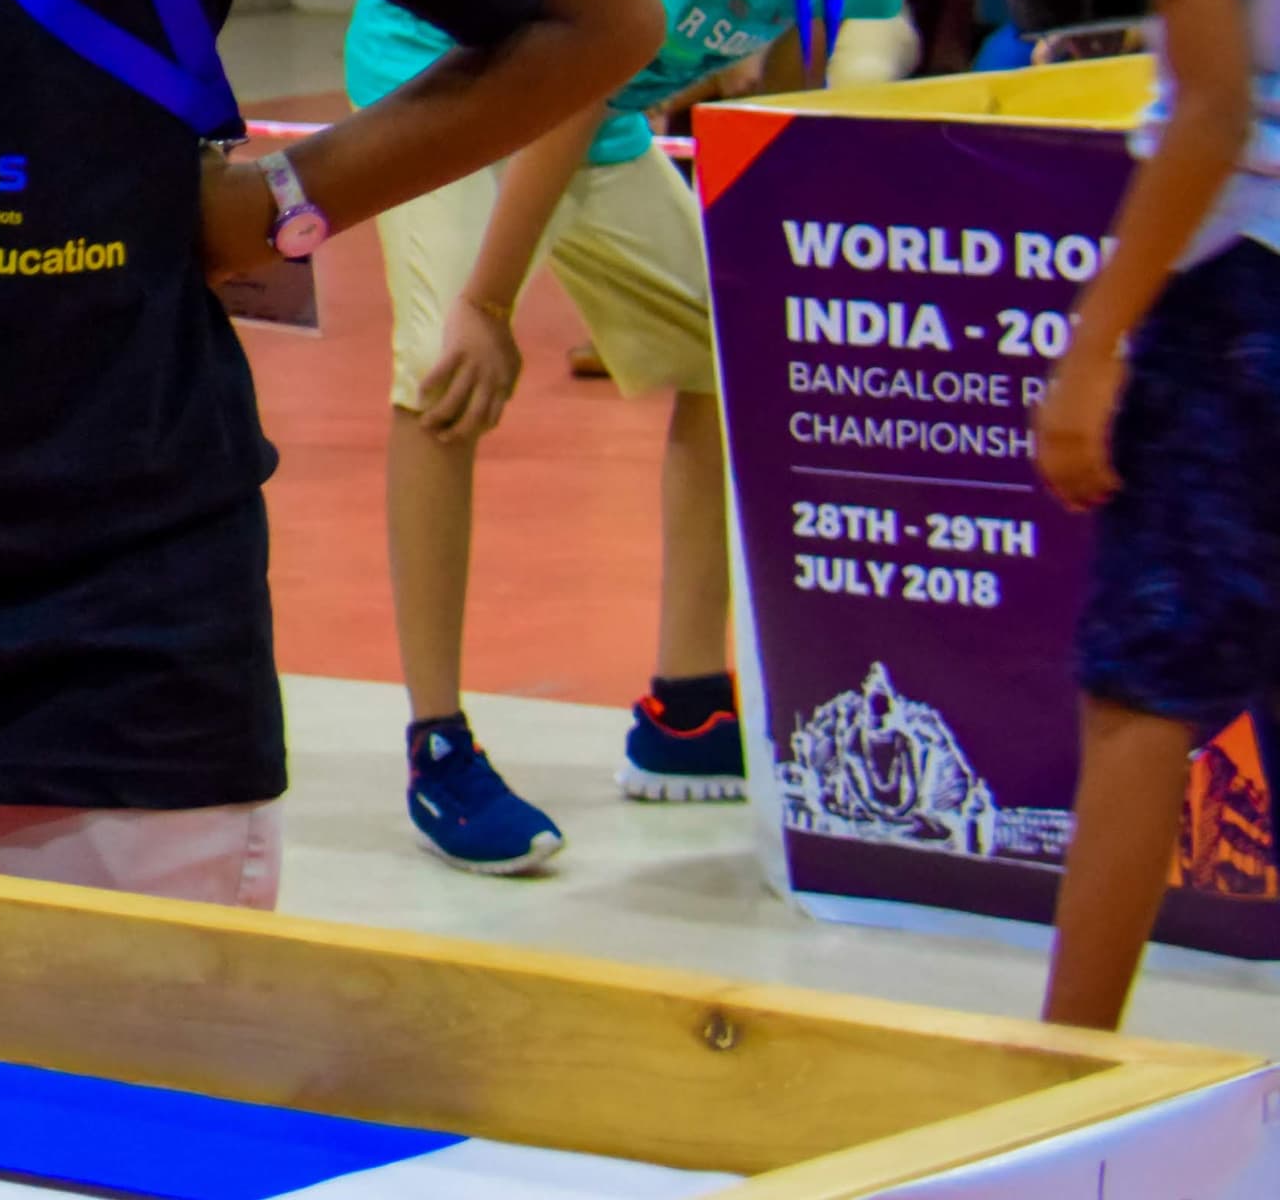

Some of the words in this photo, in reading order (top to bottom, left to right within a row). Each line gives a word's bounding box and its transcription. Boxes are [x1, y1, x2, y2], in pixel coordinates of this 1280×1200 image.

[783, 220, 1002, 277] WORLD
[786, 295, 951, 351] INDIA
[964, 323, 985, 340] -
[788, 361, 1010, 407] BANGALORE
[793, 502, 898, 545] 28TH
[926, 513, 1035, 557] 29TH
[794, 555, 895, 599] JULY
[902, 565, 1001, 607] 2018
